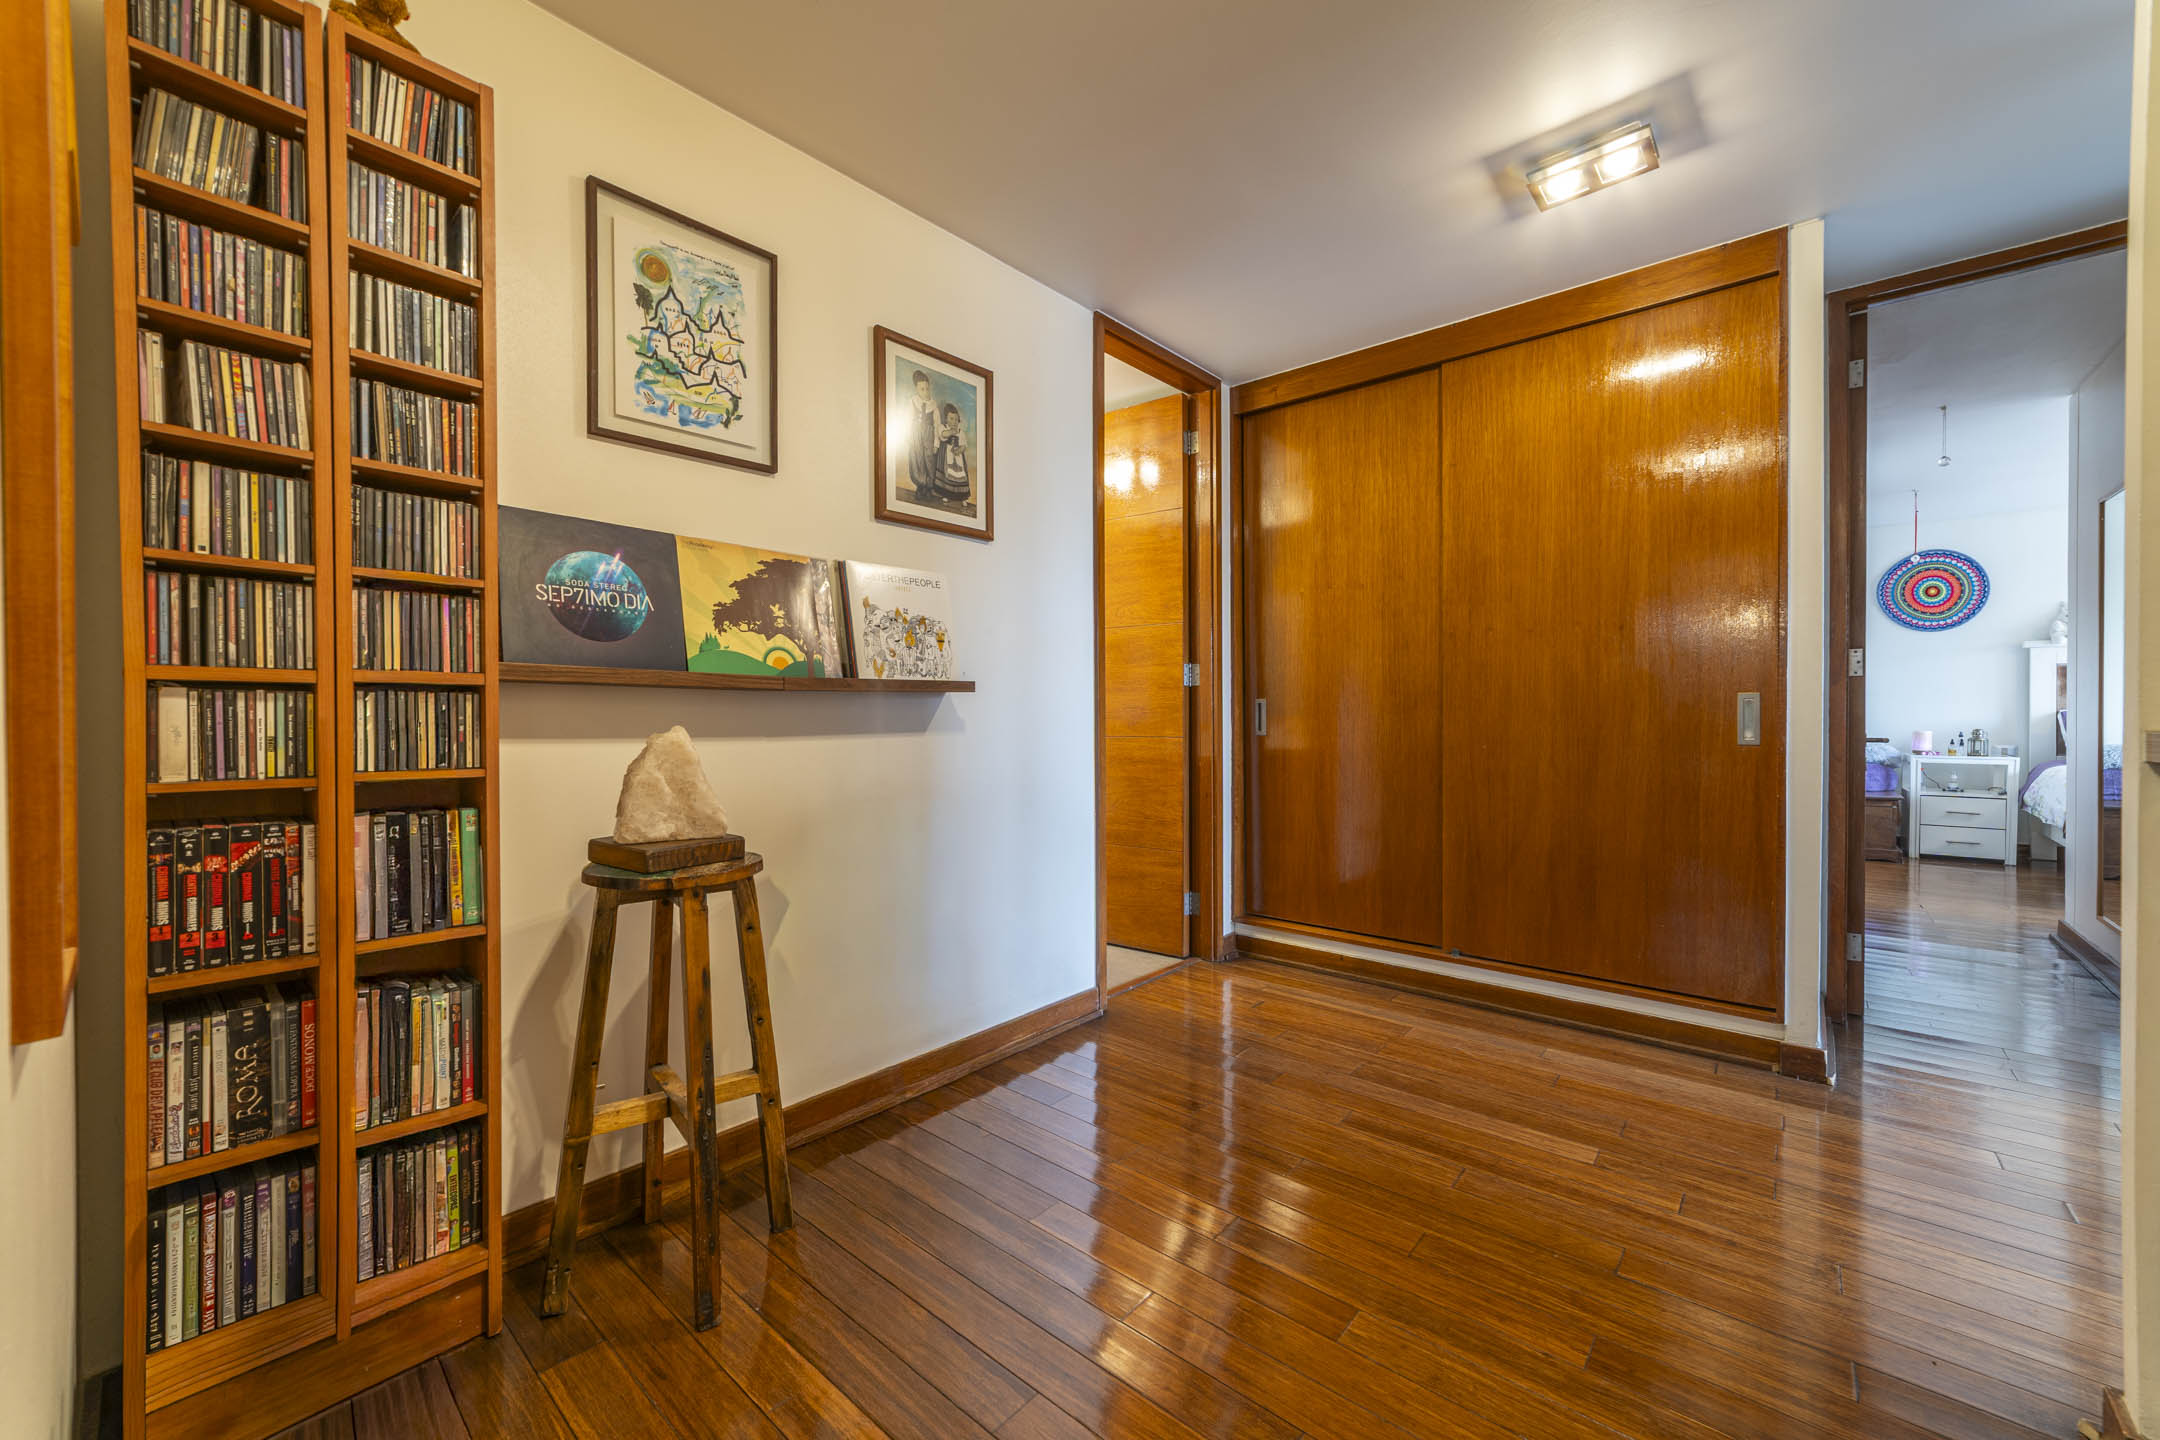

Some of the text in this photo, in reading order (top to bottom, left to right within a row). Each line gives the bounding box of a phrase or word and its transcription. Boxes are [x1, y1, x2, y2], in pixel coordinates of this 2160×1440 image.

[535, 583, 620, 609] SEP7IMO
[565, 578, 629, 592] SODA STEREO
[156, 865, 169, 926] CRIMINAL MINDS
[186, 897, 199, 932] CRIMINALES
[211, 907, 224, 932] MINDS
[241, 902, 254, 924] MINDS
[304, 1023, 315, 1093] DOCE MONOS
[150, 1071, 164, 1089] CLUB
[234, 1042, 265, 1121] ROMA
[150, 1112, 164, 1138] PELEA
